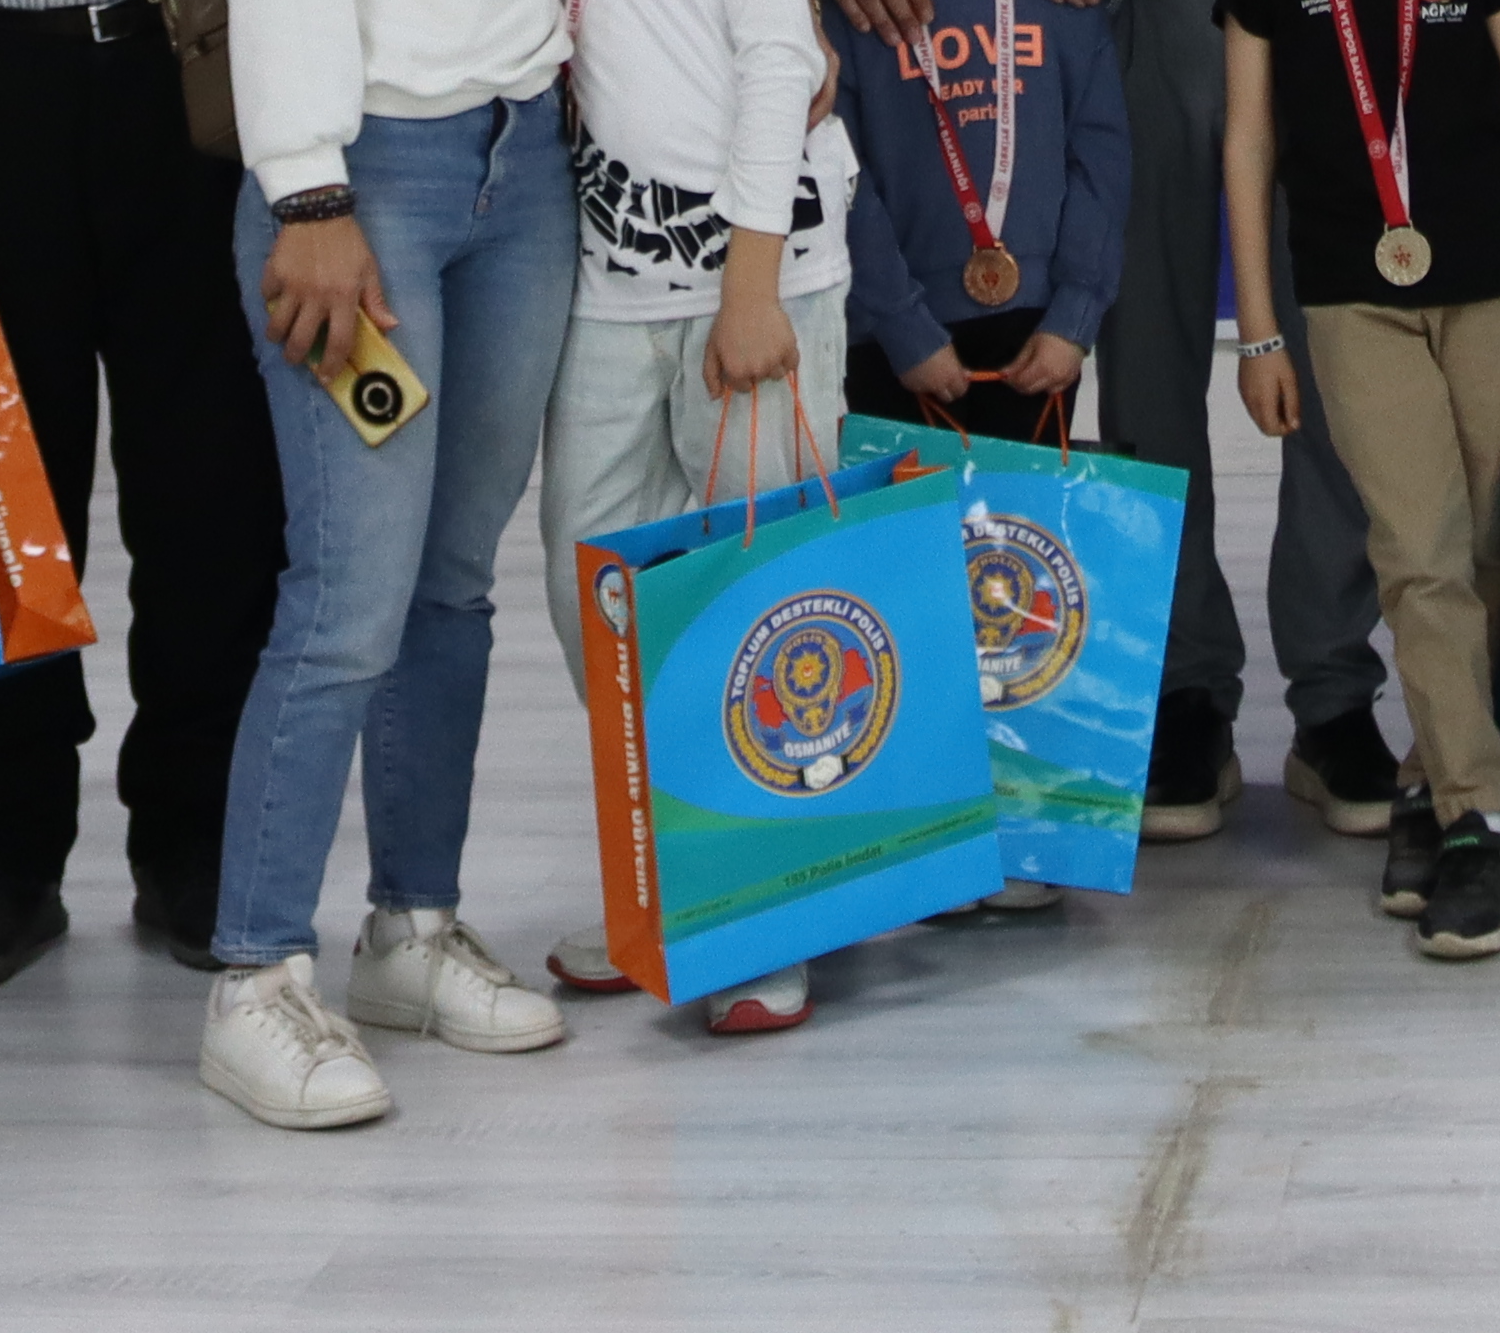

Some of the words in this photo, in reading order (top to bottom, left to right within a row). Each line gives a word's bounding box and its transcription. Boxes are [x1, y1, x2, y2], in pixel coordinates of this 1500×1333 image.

[1051, 555, 1081, 608] POLİS
[731, 624, 771, 699] TOPLUM
[770, 597, 850, 630] DESTEKLİ
[850, 607, 886, 652] POLİS
